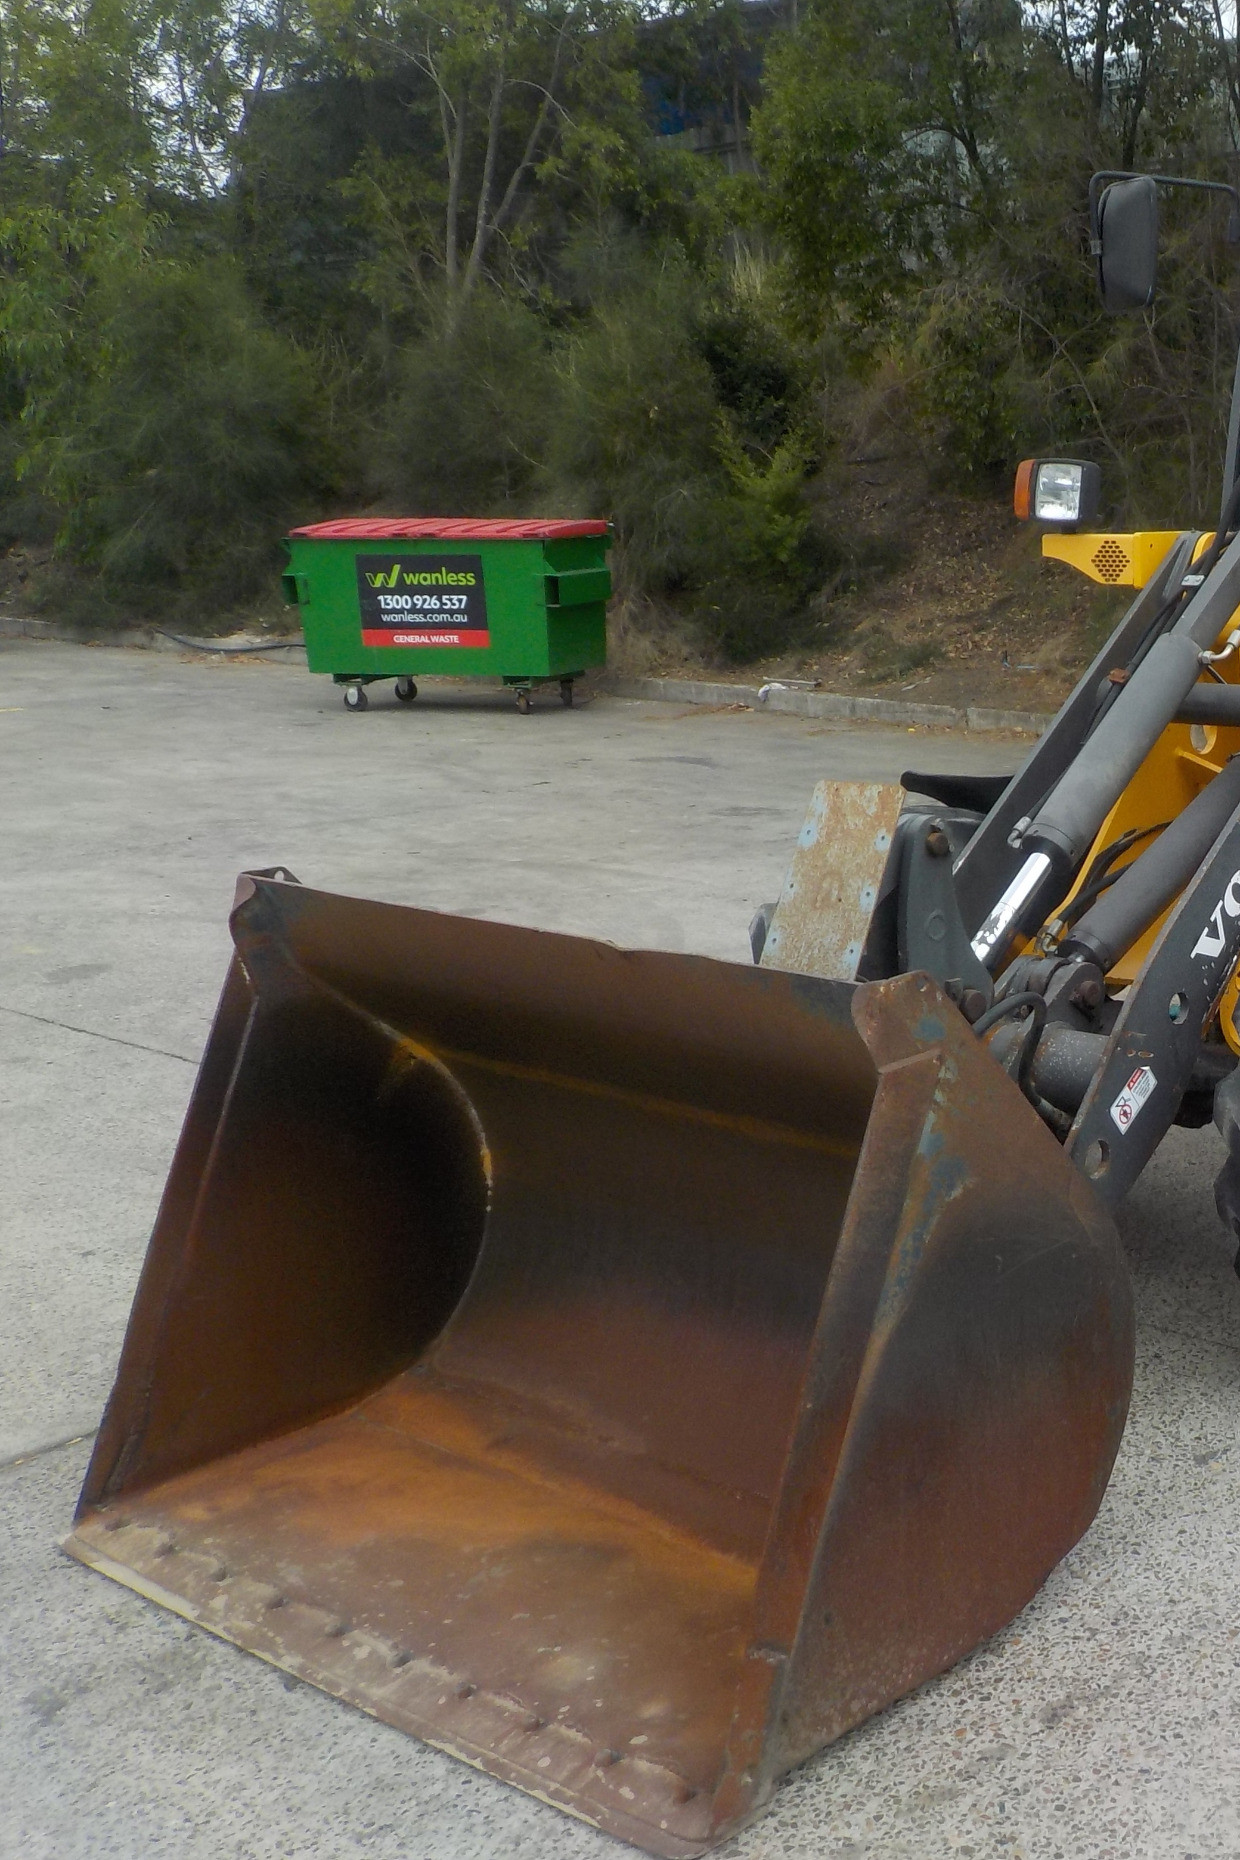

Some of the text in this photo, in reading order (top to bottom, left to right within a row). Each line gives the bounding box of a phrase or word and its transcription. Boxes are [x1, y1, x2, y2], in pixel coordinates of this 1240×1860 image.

[403, 566, 476, 586] wanless
[377, 594, 468, 610] 1300 926 537
[381, 610, 468, 623] wanless.com.au
[393, 634, 460, 644] GENERAL WASTE
